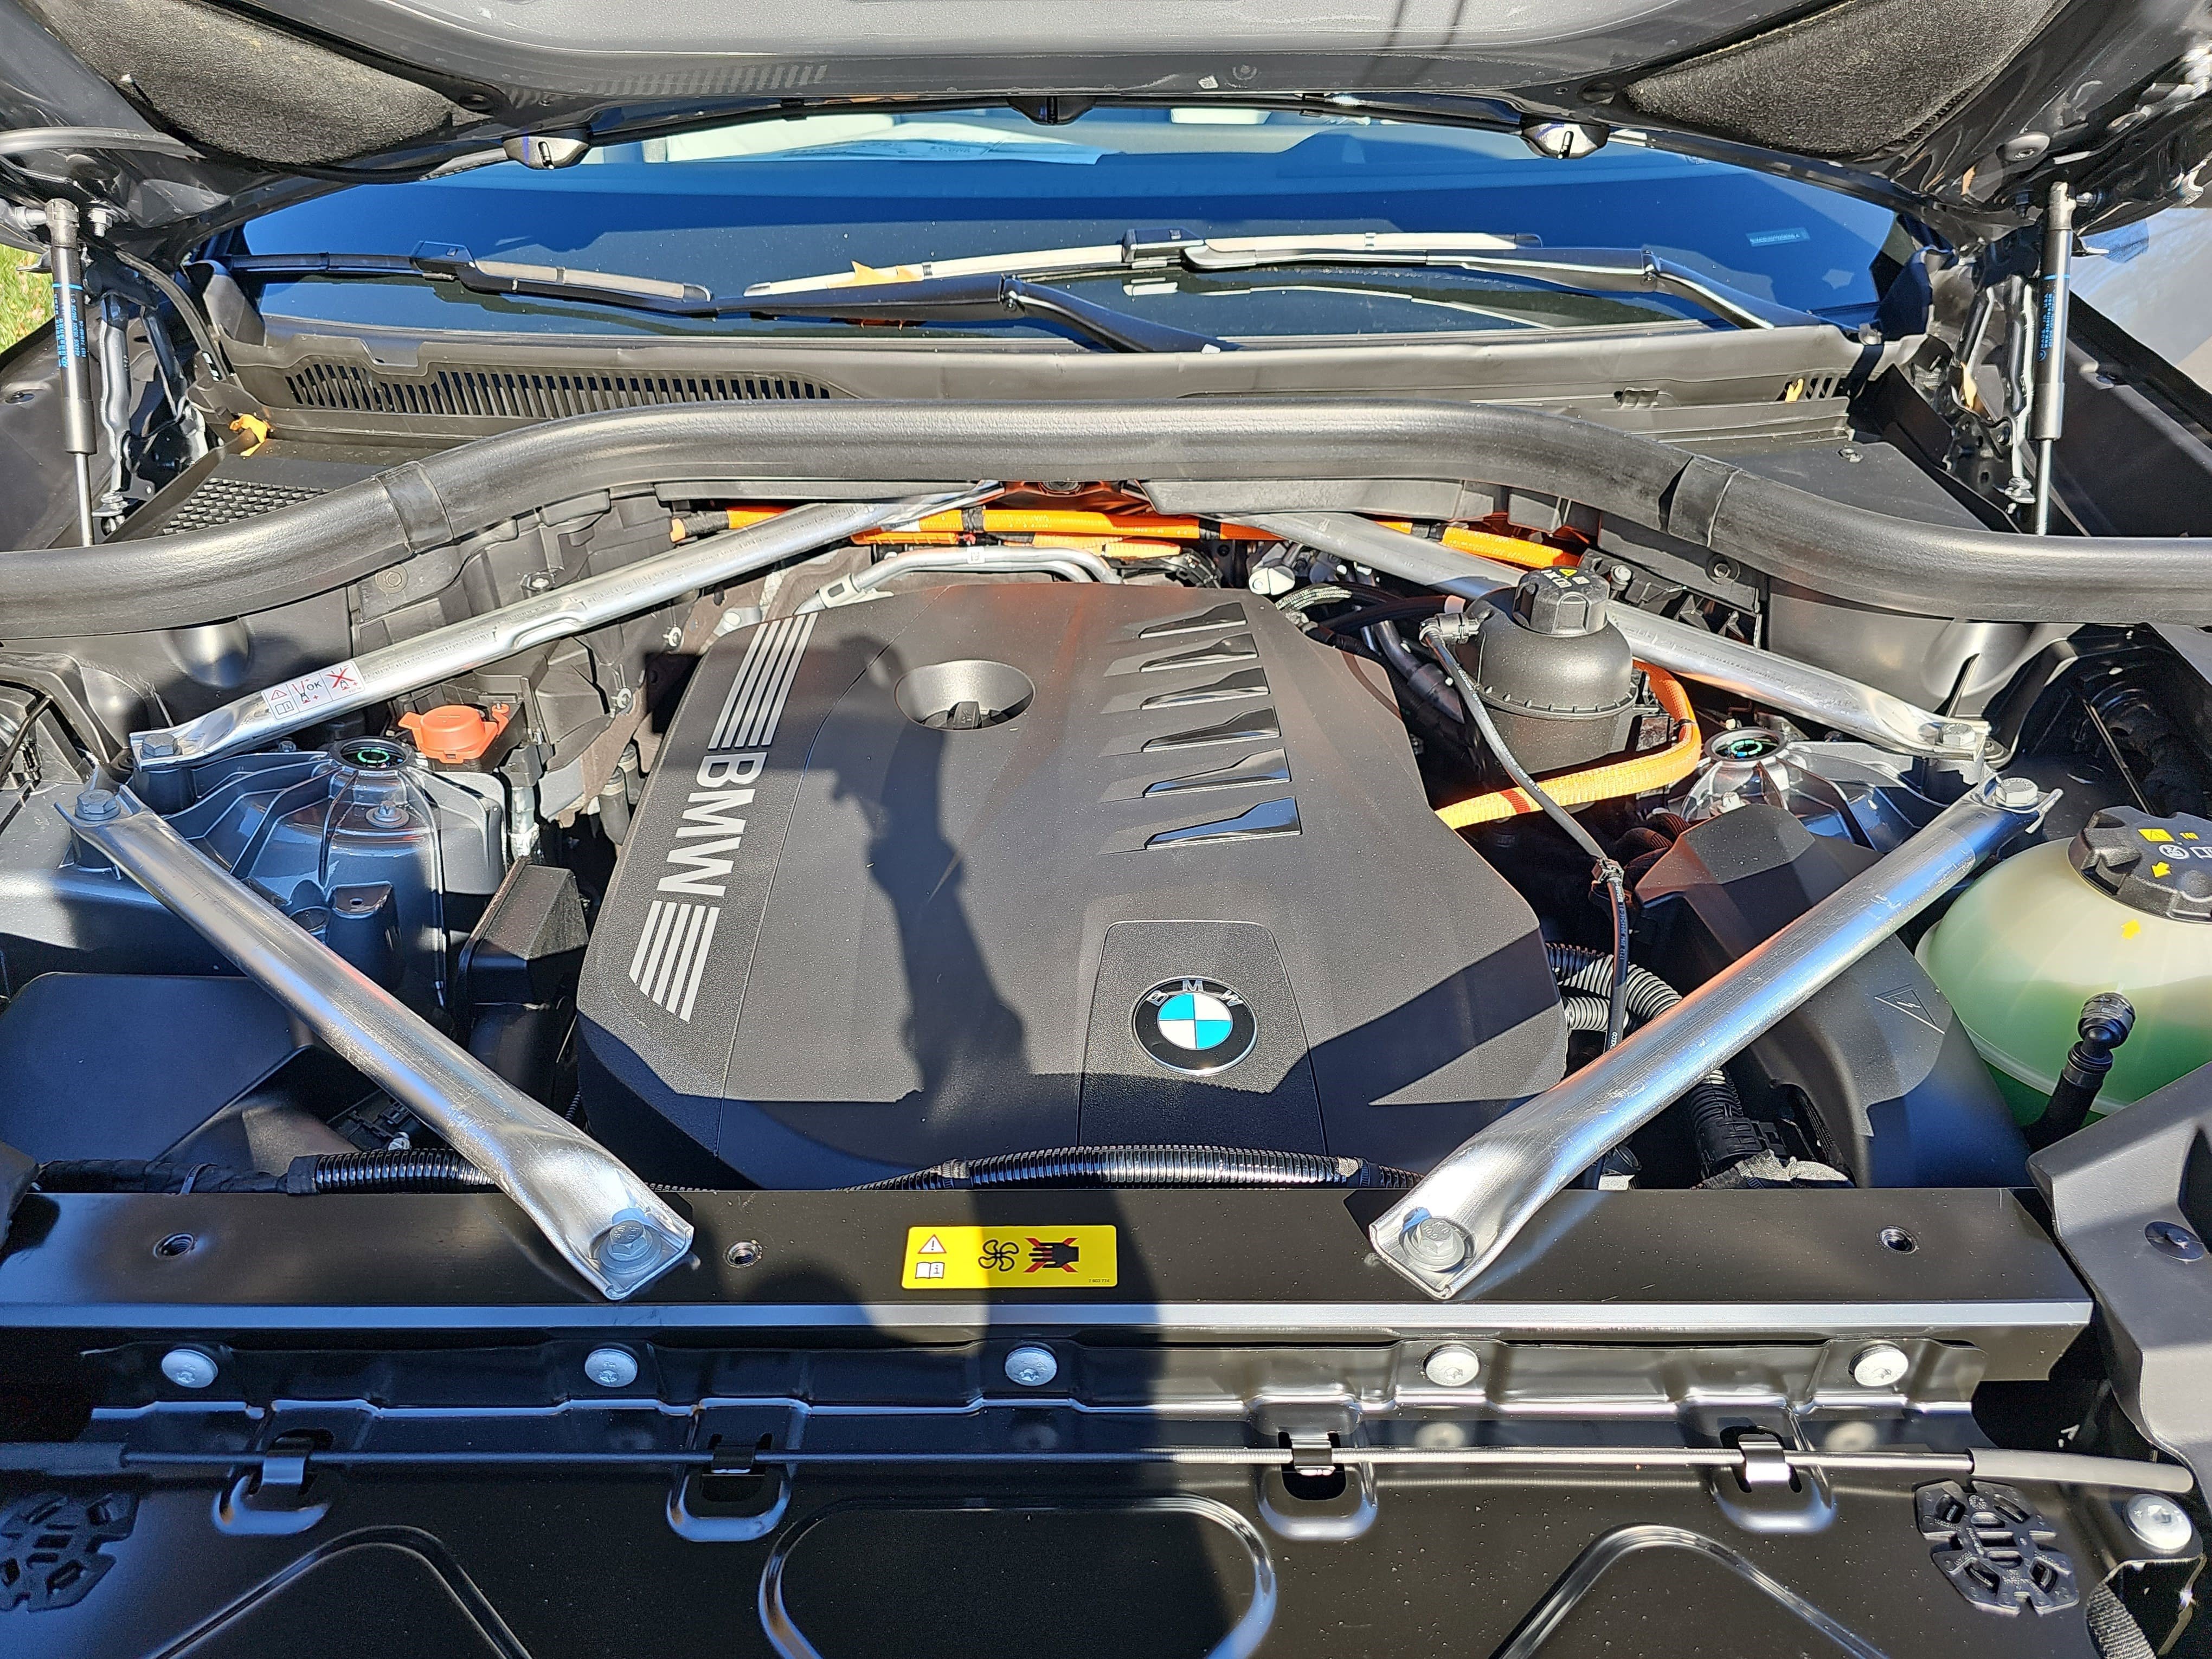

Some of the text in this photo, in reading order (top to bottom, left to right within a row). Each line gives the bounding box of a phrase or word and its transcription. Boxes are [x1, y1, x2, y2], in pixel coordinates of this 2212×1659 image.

[306, 680, 323, 691] OK
[657, 751, 768, 897] BMW
[1146, 979, 1244, 1007] BMW
